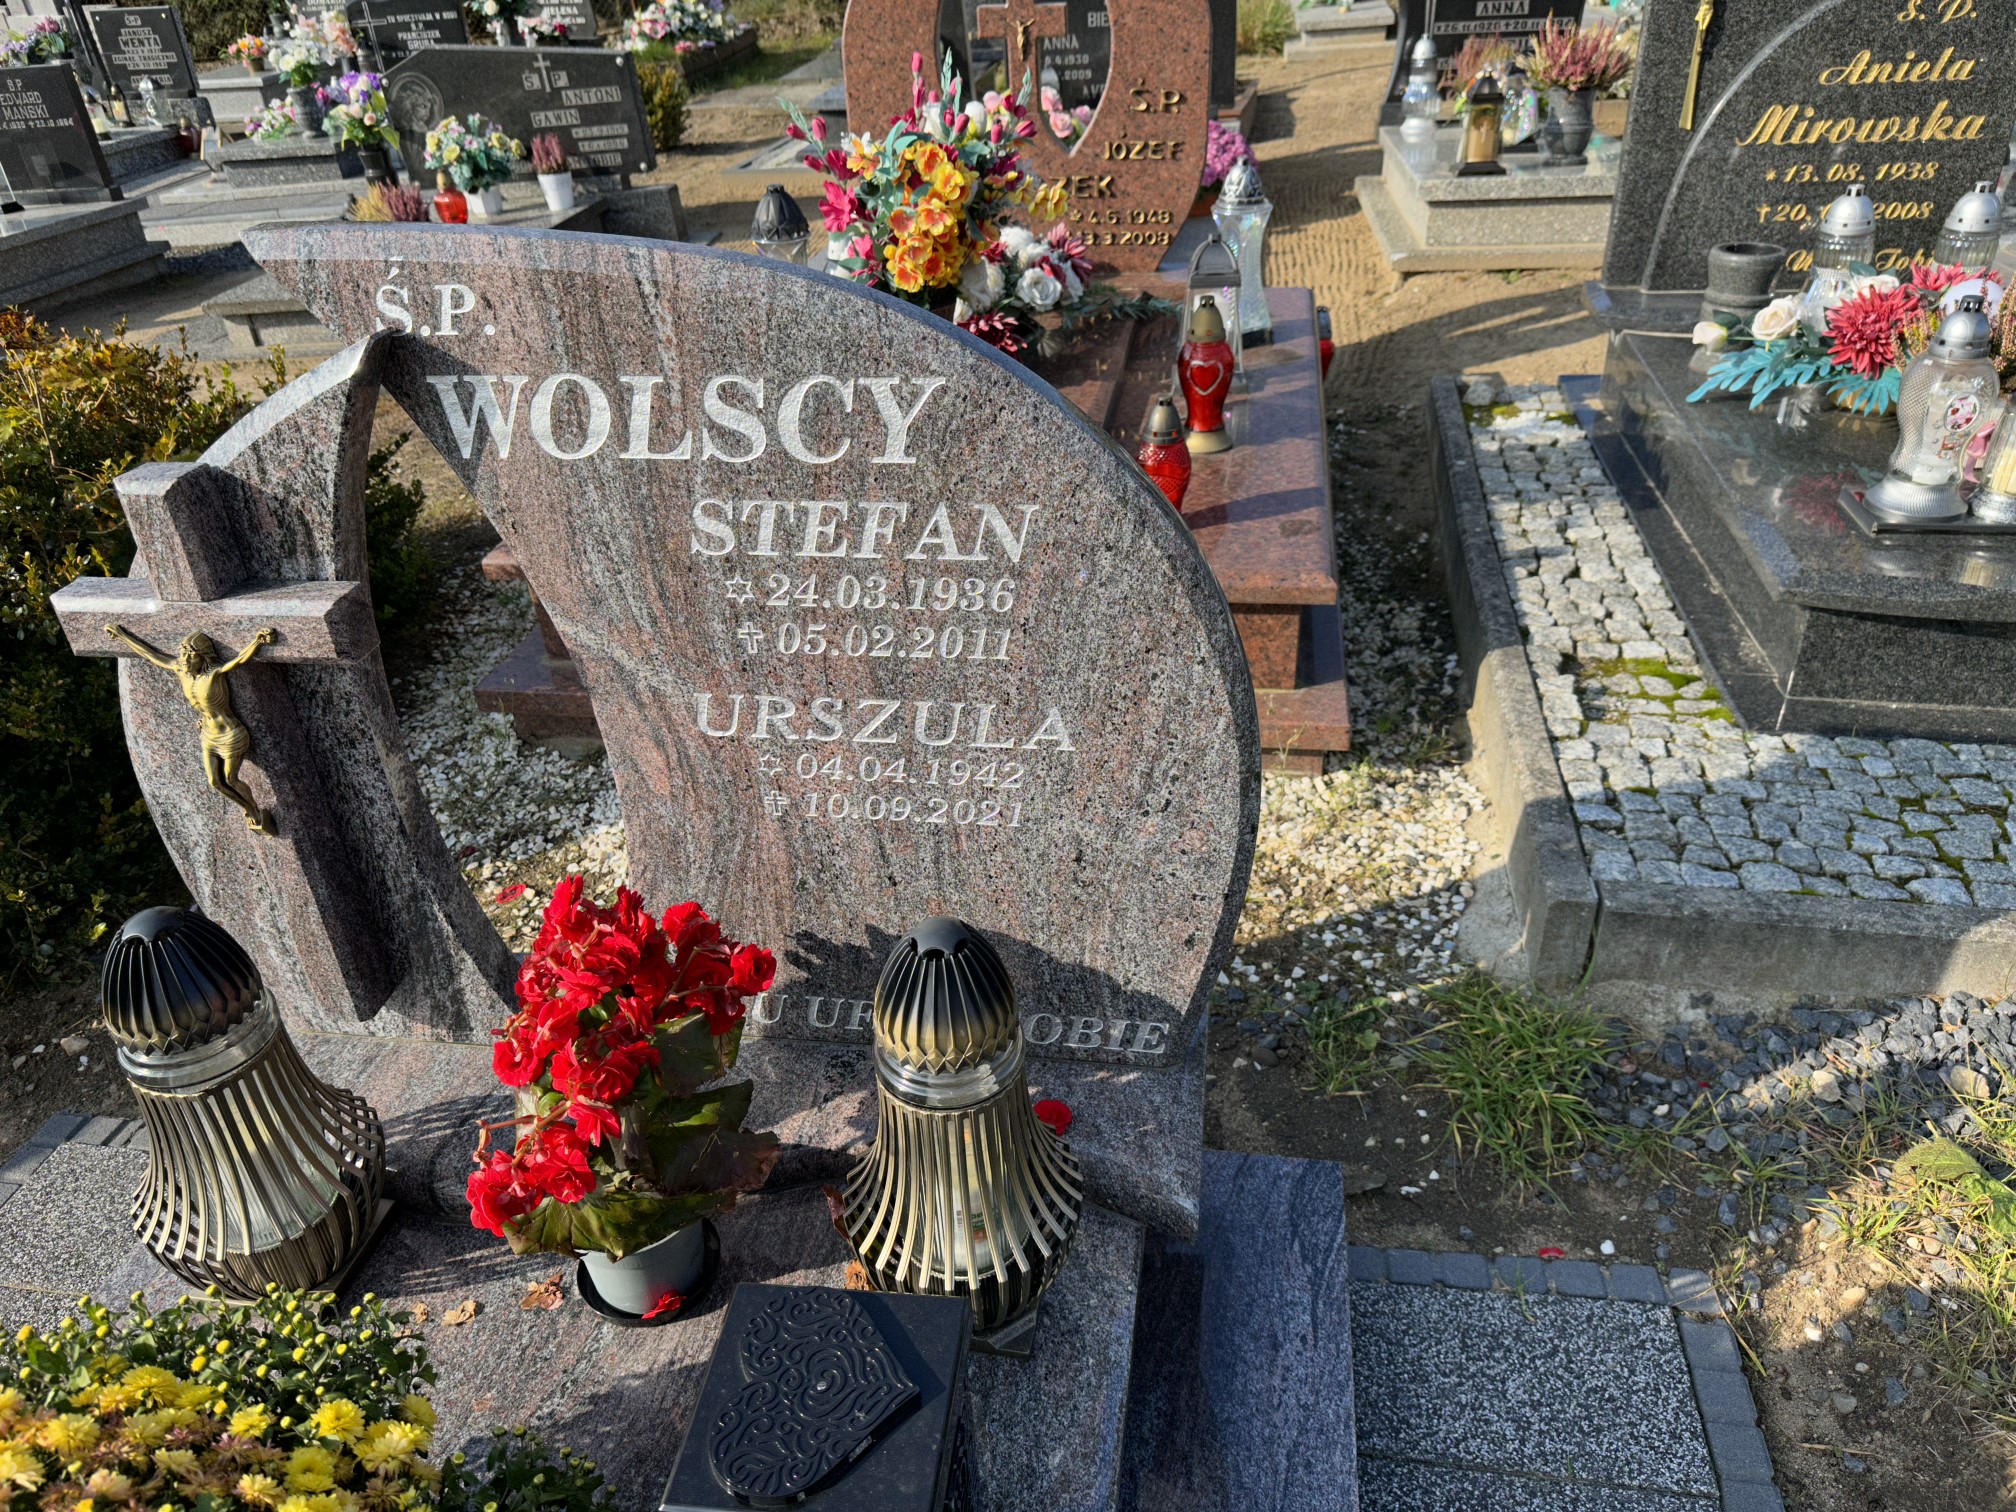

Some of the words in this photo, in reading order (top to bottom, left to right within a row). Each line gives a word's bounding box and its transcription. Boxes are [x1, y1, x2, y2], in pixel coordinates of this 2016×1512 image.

[1087, 11, 1110, 28] BIE
[1480, 2, 1526, 15] ANNA
[120, 37, 161, 49] WENTA
[1043, 34, 1080, 50] ANNA
[1818, 46, 1977, 86] Aniela
[0, 91, 42, 105] EDWARD
[563, 87, 620, 105] ANTONI
[532, 109, 579, 127] GAWIN
[1735, 99, 1986, 147] Mirowska
[1783, 163, 1820, 183] 13.
[1826, 161, 1866, 182] 08.
[1875, 160, 1941, 182] 1938
[427, 371, 946, 465] WOLSCY
[690, 497, 1040, 564] STEFAN
[766, 573, 1017, 613] 24.03.1936
[776, 622, 1012, 661] 05.02.2011
[692, 692, 1077, 752] URSZULA
[796, 753, 1026, 789] 04.04.1942
[805, 793, 1022, 828] 10.09.2021
[805, 995, 875, 1030] UF
[1022, 1012, 1170, 1055] OBIE
